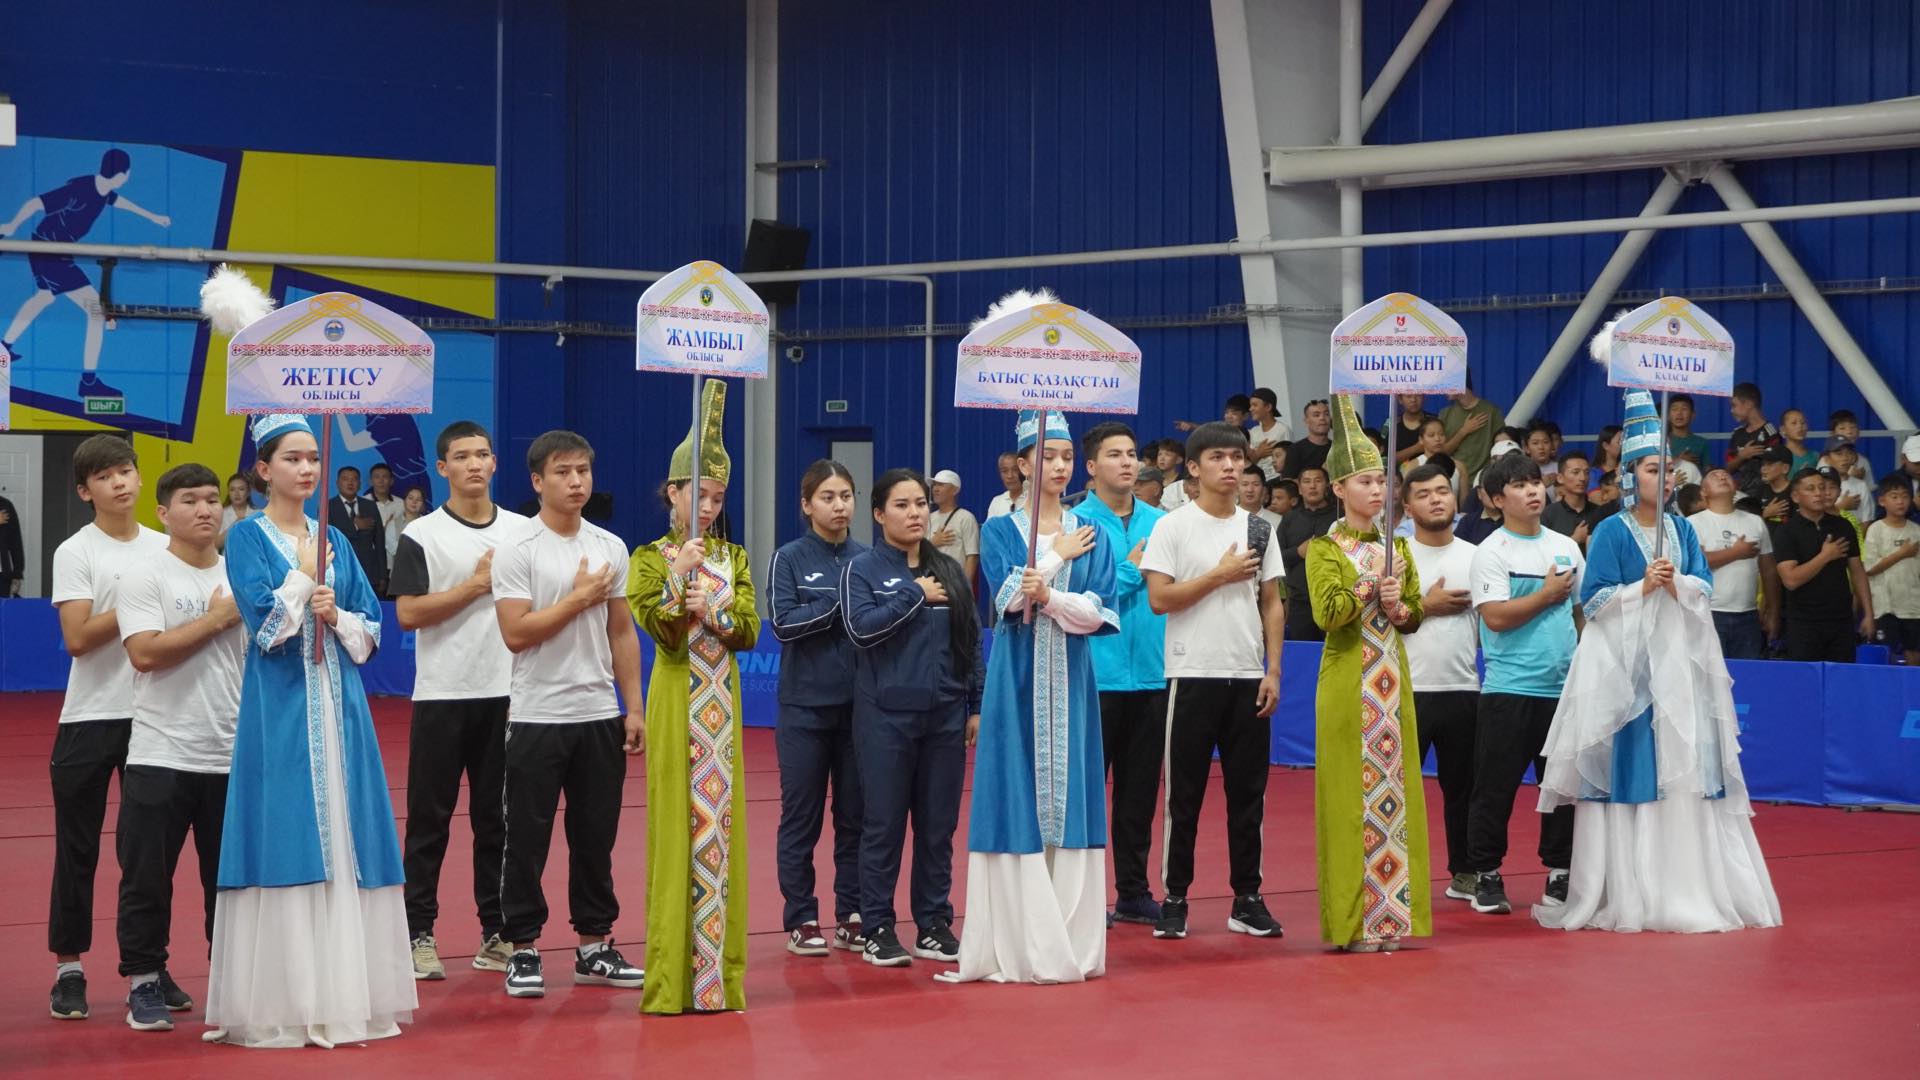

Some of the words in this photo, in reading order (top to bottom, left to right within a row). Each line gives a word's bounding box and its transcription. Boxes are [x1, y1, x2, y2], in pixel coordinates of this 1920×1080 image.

[666, 328, 744, 351] ЖАМБЫЛ
[686, 351, 724, 363] ОБЛЫСЫ
[1353, 355, 1446, 371] ШЫМКЕНТ
[1638, 353, 1706, 372] АЛМАТЫ
[281, 367, 383, 386] ЖЕТІСУ
[978, 371, 1030, 385] БАТЫС
[1033, 374, 1120, 389] ҚАЗАҚСТАН
[1381, 374, 1418, 383] ҚАЛАСЫ
[302, 390, 361, 401] ОБЛЫСЫ
[1022, 389, 1074, 400] ОБЛЫСЫ
